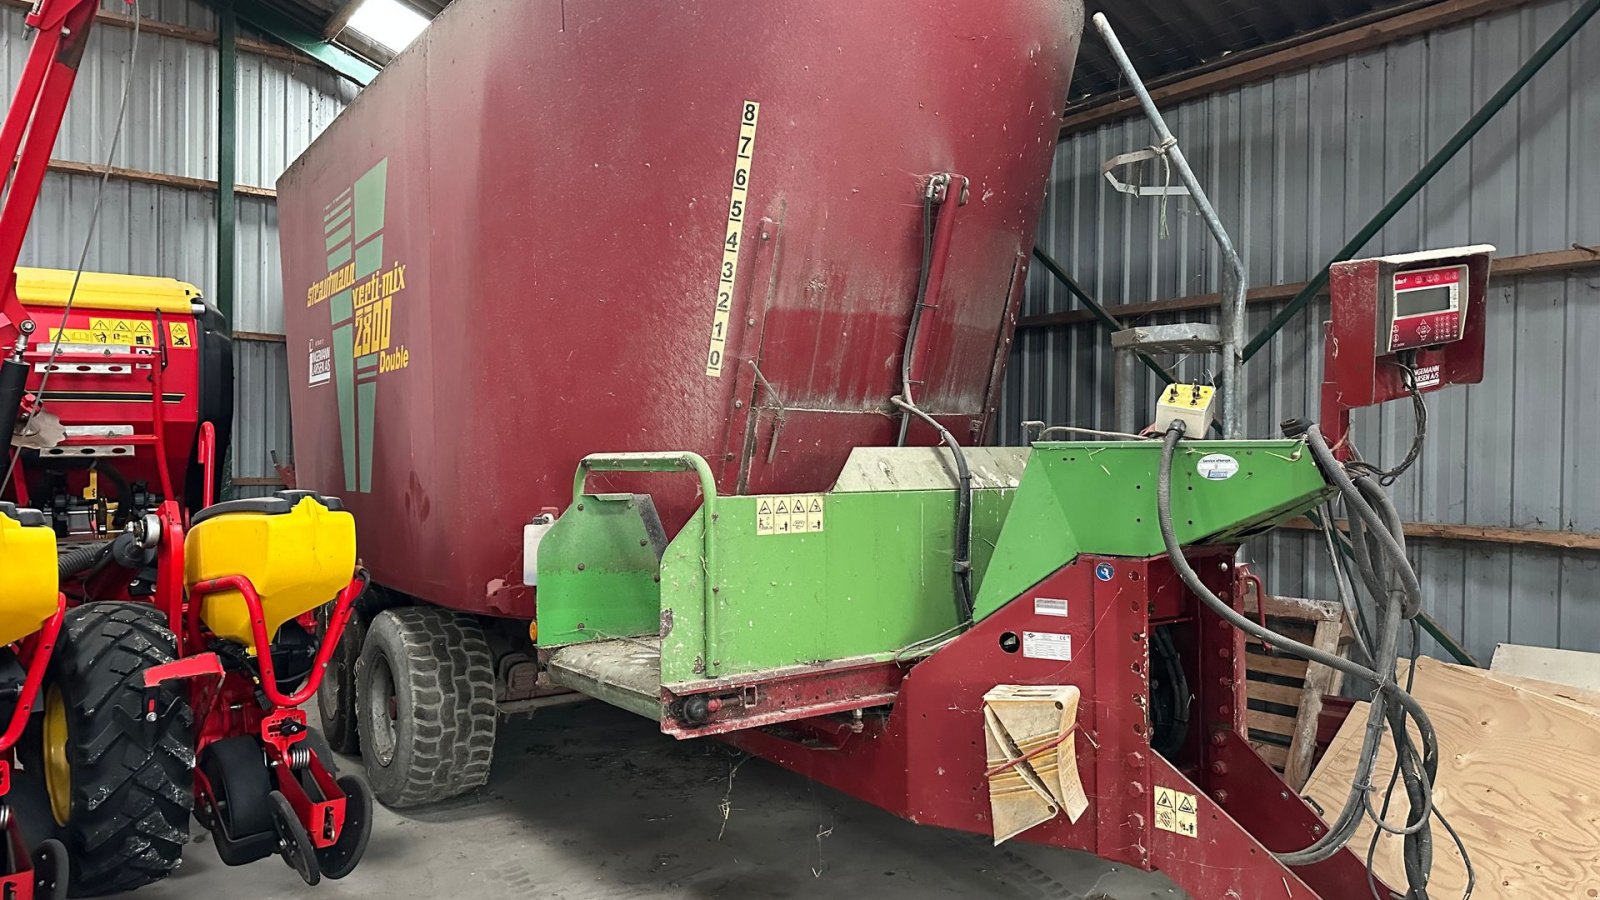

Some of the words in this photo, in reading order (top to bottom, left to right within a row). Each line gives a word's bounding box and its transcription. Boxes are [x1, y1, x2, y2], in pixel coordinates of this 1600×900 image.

[744, 104, 756, 121] 8
[740, 136, 752, 154] 7
[735, 168, 746, 186] 6
[731, 200, 742, 218] 5
[726, 232, 738, 248] 4
[722, 262, 733, 279] 3
[307, 262, 356, 308] strautmann
[718, 293, 729, 309] 2
[353, 296, 392, 358] 2800
[714, 322, 723, 337] 1
[379, 345, 409, 374] Double
[710, 351, 720, 366] 0
[1414, 365, 1440, 376] NGEMANN
[1414, 373, 1430, 382] ARSEN
